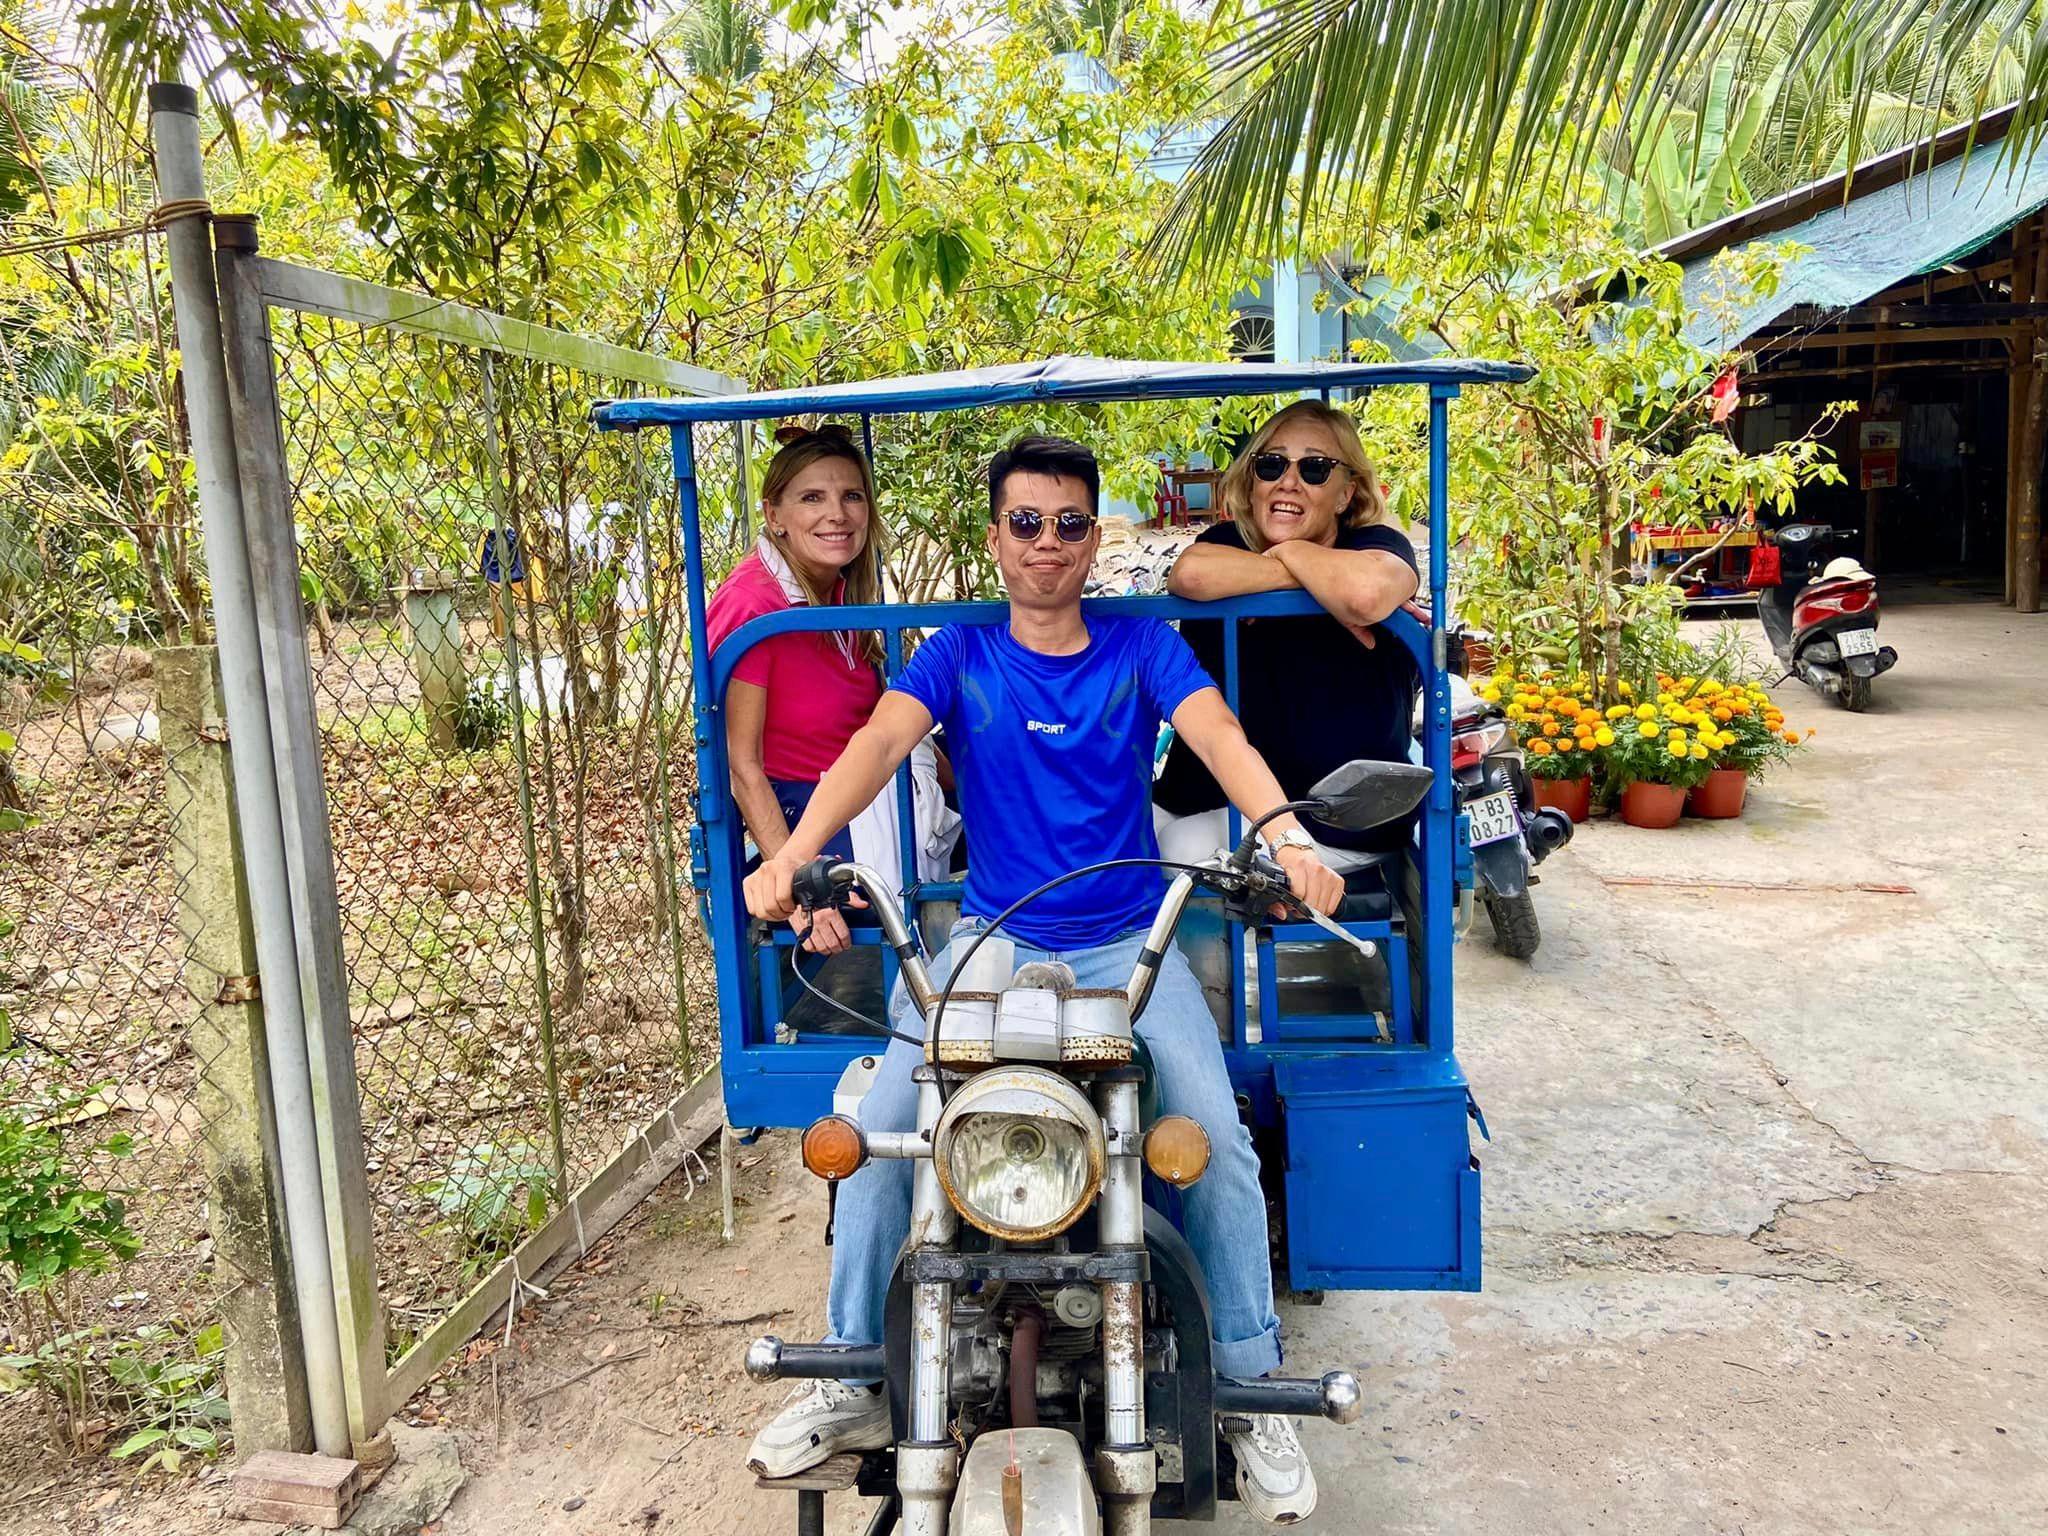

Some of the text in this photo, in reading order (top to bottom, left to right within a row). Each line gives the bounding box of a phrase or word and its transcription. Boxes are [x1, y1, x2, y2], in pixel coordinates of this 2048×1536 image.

[1846, 640, 1874, 655] 2555
[1027, 720, 1066, 735] SPORT
[1464, 798, 1505, 821] 1-B3
